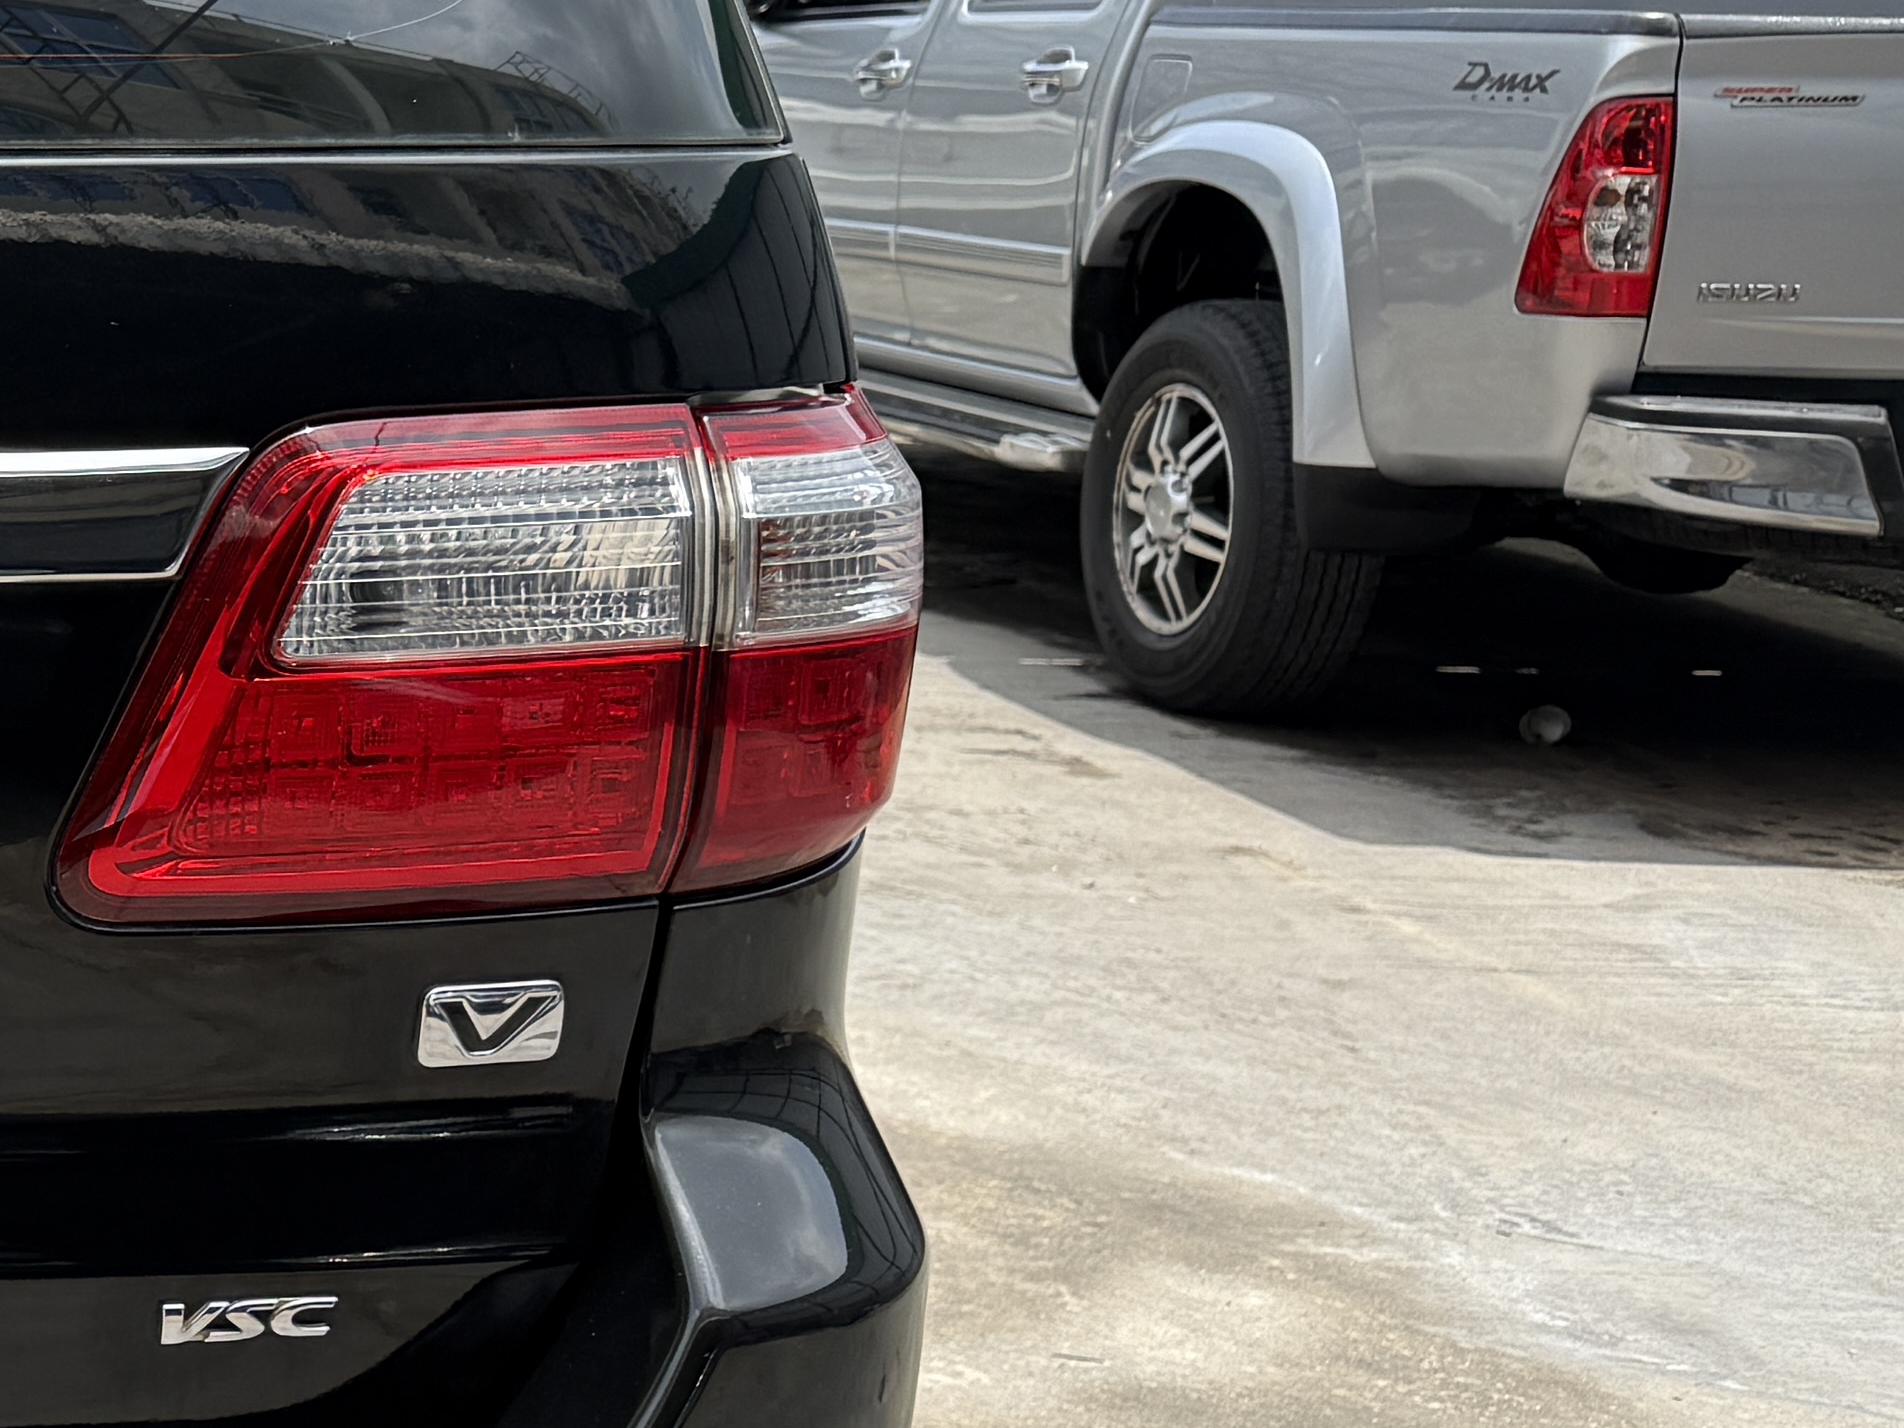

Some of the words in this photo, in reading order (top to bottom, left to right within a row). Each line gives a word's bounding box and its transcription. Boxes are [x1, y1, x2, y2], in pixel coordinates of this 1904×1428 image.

[1738, 94, 1859, 103] PLATINUM
[1697, 282, 1800, 304] ISUZU
[160, 1295, 339, 1346] VSC
